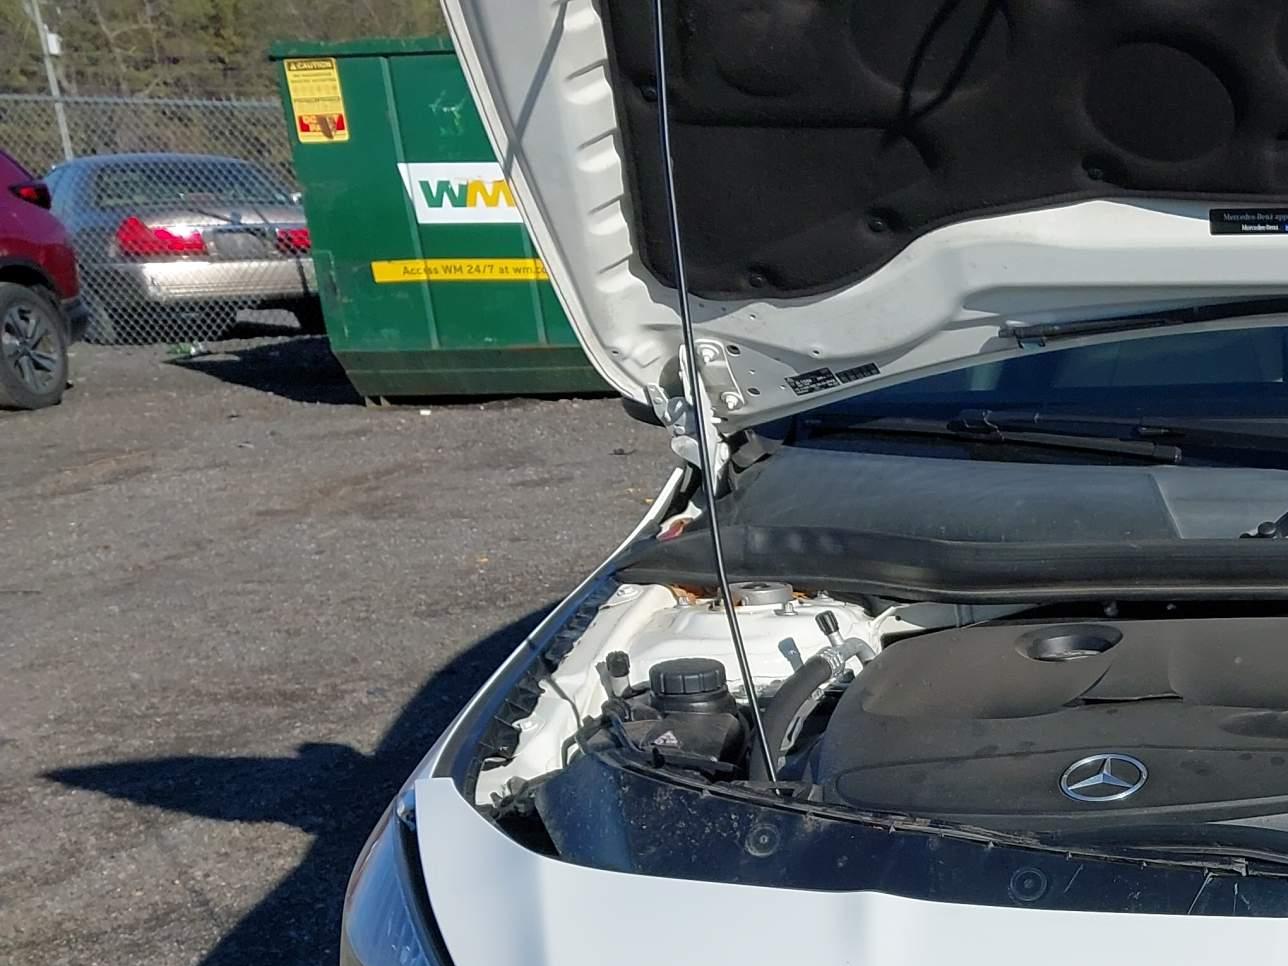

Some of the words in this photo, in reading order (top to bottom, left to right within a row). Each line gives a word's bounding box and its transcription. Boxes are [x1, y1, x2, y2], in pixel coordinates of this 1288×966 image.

[419, 180, 516, 208] WM
[402, 265, 439, 276] Access
[441, 265, 463, 275] WM
[466, 265, 494, 275] 24/7
[497, 265, 510, 275] at
